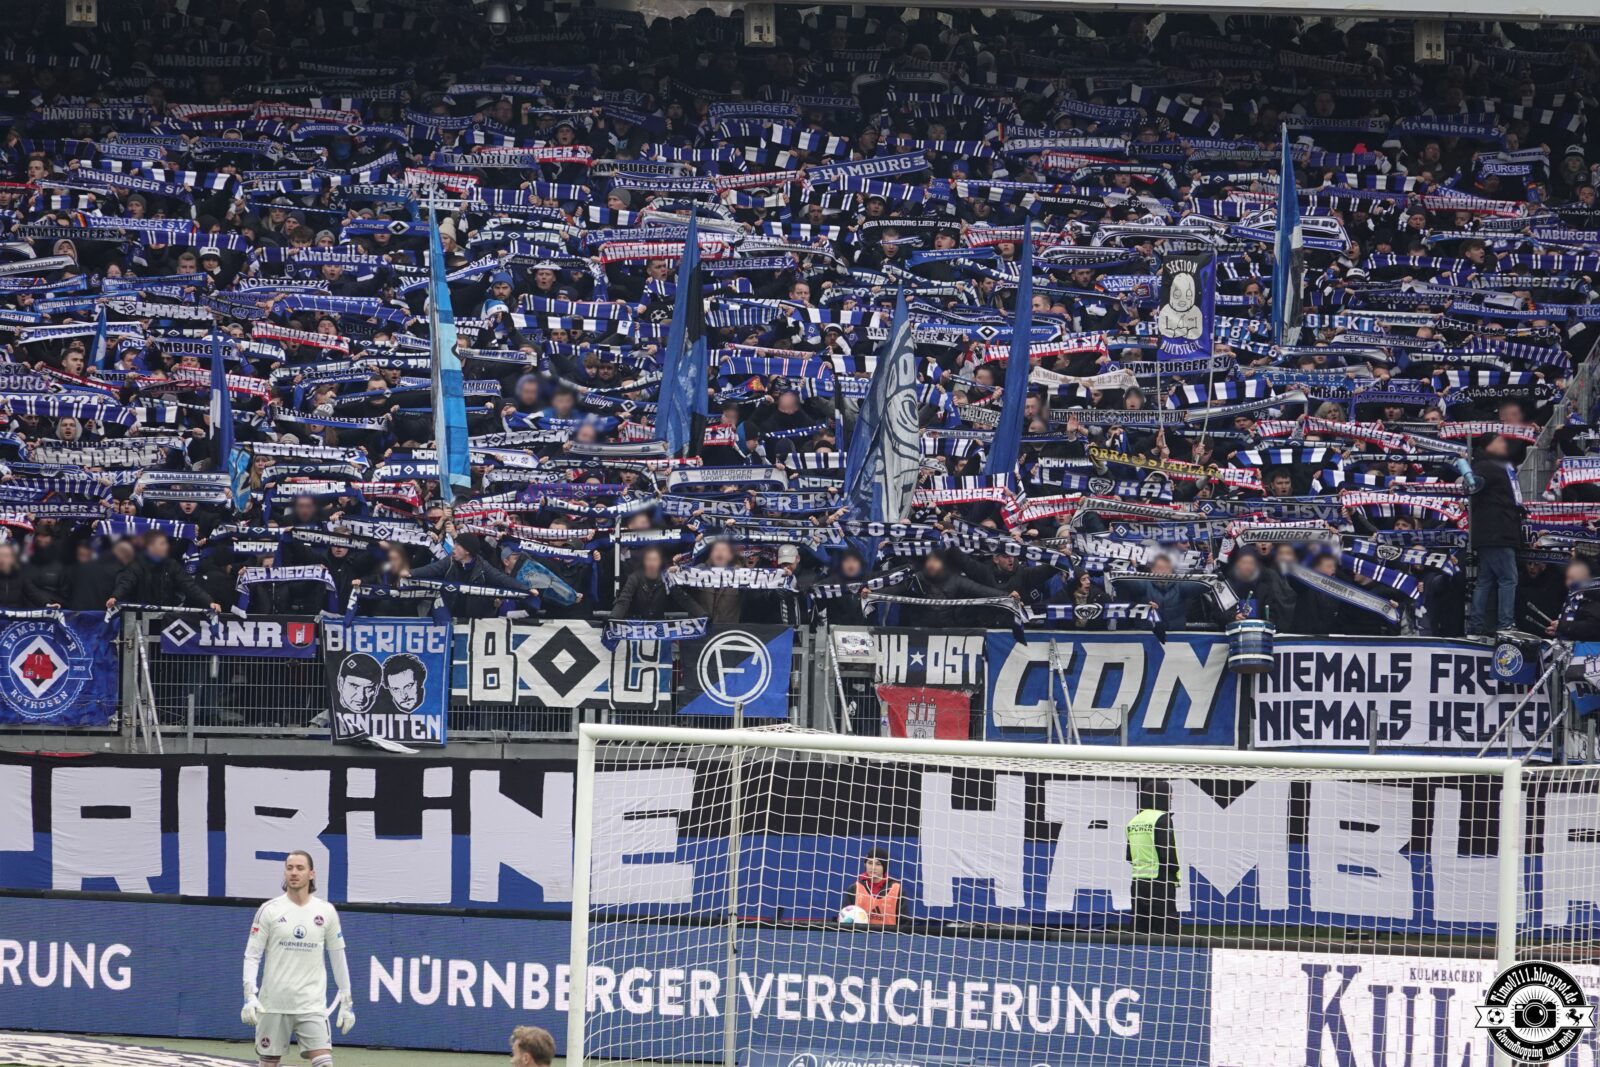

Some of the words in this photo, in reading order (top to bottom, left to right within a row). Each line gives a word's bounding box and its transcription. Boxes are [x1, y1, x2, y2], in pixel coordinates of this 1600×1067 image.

[1062, 101, 1120, 117] AMBURGER
[1007, 126, 1045, 137] MEINE
[112, 136, 177, 146] AMBURGER
[821, 156, 911, 180] HAMBURG
[1482, 163, 1531, 175] BURGER
[77, 168, 160, 190] HAMBURGER
[165, 182, 185, 195] SV
[344, 186, 411, 198] URGESTEI
[1425, 199, 1515, 213] HAMBURGER
[90, 218, 163, 229] HAMBURGER
[879, 220, 918, 228] HAMBURG
[18, 228, 109, 239] HAMBURGER
[1534, 230, 1598, 241] AMBURGER
[604, 243, 686, 260] HAMBURGE
[701, 259, 770, 270] AMBURGER
[1166, 259, 1198, 275] SEKTION
[1471, 275, 1558, 289] HAMBURGER
[1561, 276, 1583, 290] SV
[152, 341, 232, 356] MBURGR
[1213, 356, 1231, 369] SV
[463, 382, 498, 391] AMBURG
[1090, 447, 1129, 463] ORRA
[700, 469, 753, 477] HAMBURGER
[797, 493, 840, 510] HSV
[1342, 492, 1444, 511] HAMBURGER
[1129, 523, 1188, 541] SUPER
[270, 566, 322, 580] WIEDER
[663, 617, 707, 638] HSV
[3, 622, 77, 653] ERMSTAR
[325, 624, 445, 653] BIERIGE
[873, 634, 909, 684] HH
[927, 634, 985, 685] OST
[1258, 652, 1412, 694] NIEMALS
[1430, 653, 1545, 696] FRE
[993, 642, 1228, 729] CDN
[11, 690, 68, 709] ROTHOSEN
[1258, 700, 1412, 742] NIEMALS
[1409, 967, 1483, 983] KULMBACHER
[370, 954, 722, 1018] NÜRNBERGER
[738, 970, 1142, 1038] VERSICHERUNG
